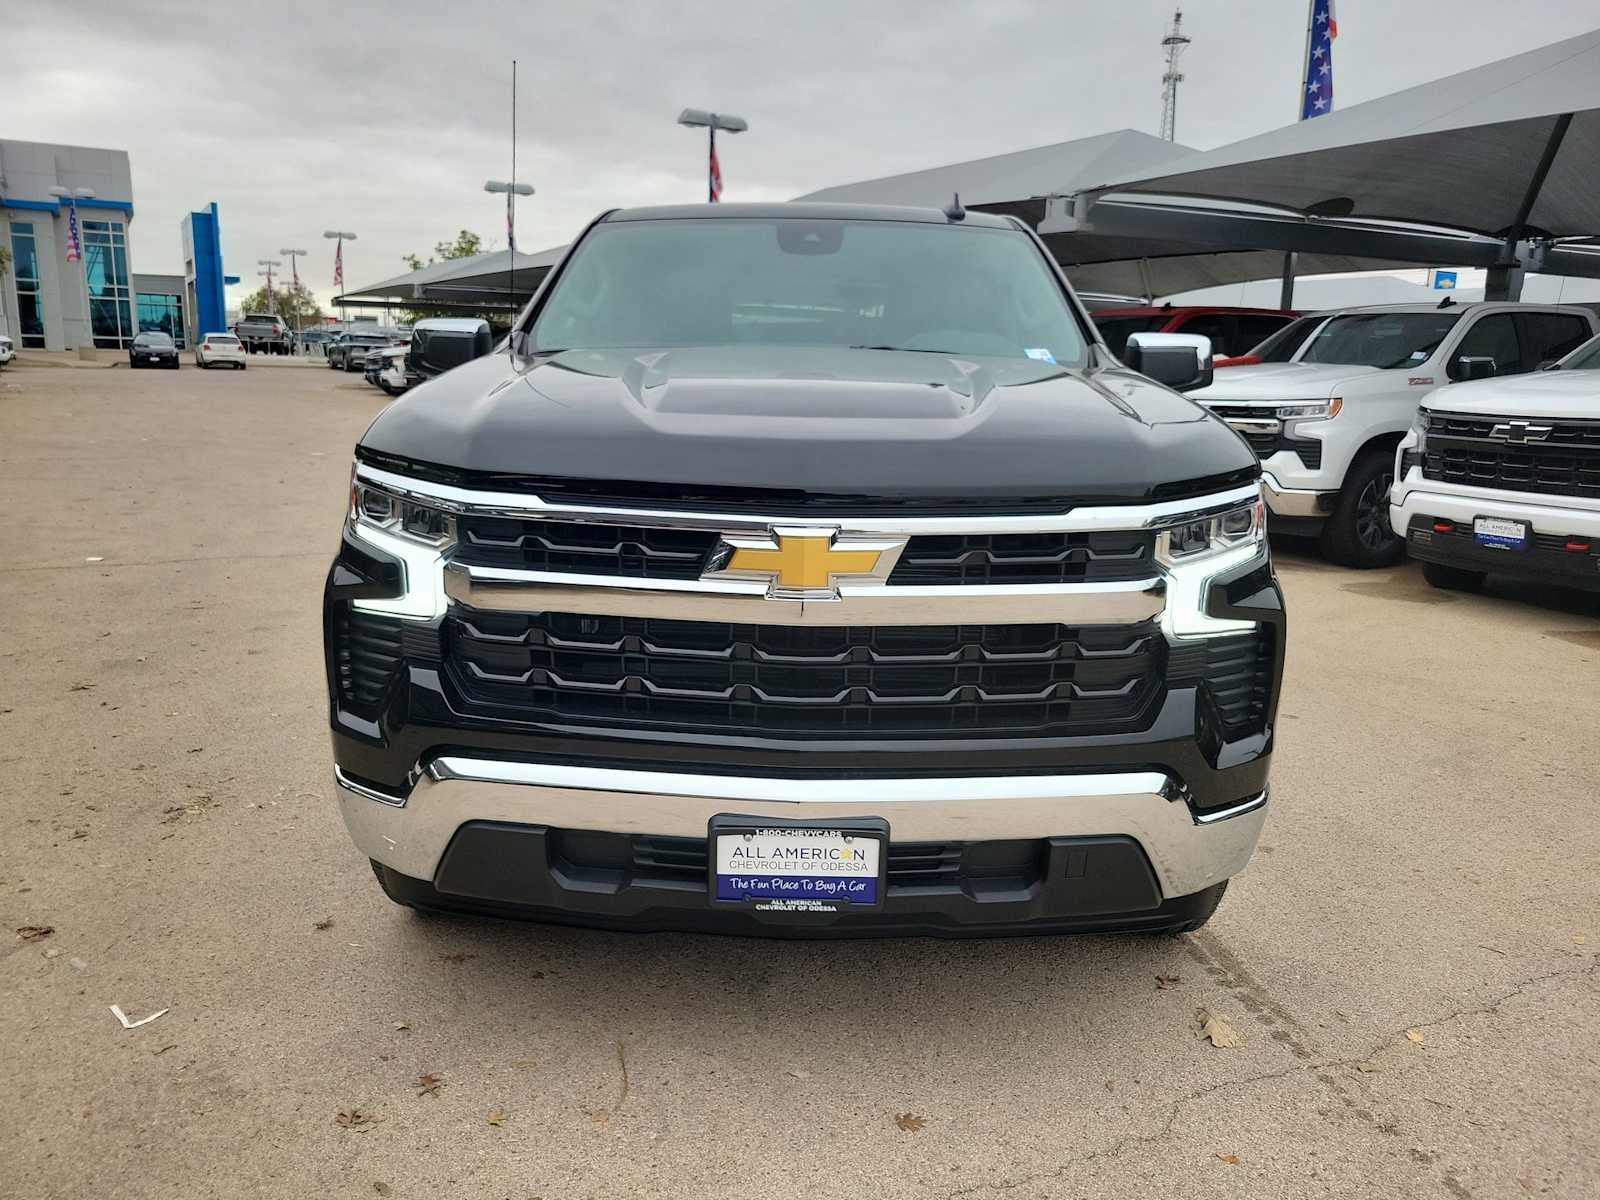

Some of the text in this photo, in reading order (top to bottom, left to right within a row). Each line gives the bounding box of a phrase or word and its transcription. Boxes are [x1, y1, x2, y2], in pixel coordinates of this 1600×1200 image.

[755, 829, 842, 837] 1-800-CHEVYCARS
[732, 847, 766, 858] ALL
[729, 860, 869, 871] CHEVROLET OF ODESSA
[729, 877, 867, 894] The Fun Place To Buy A Car
